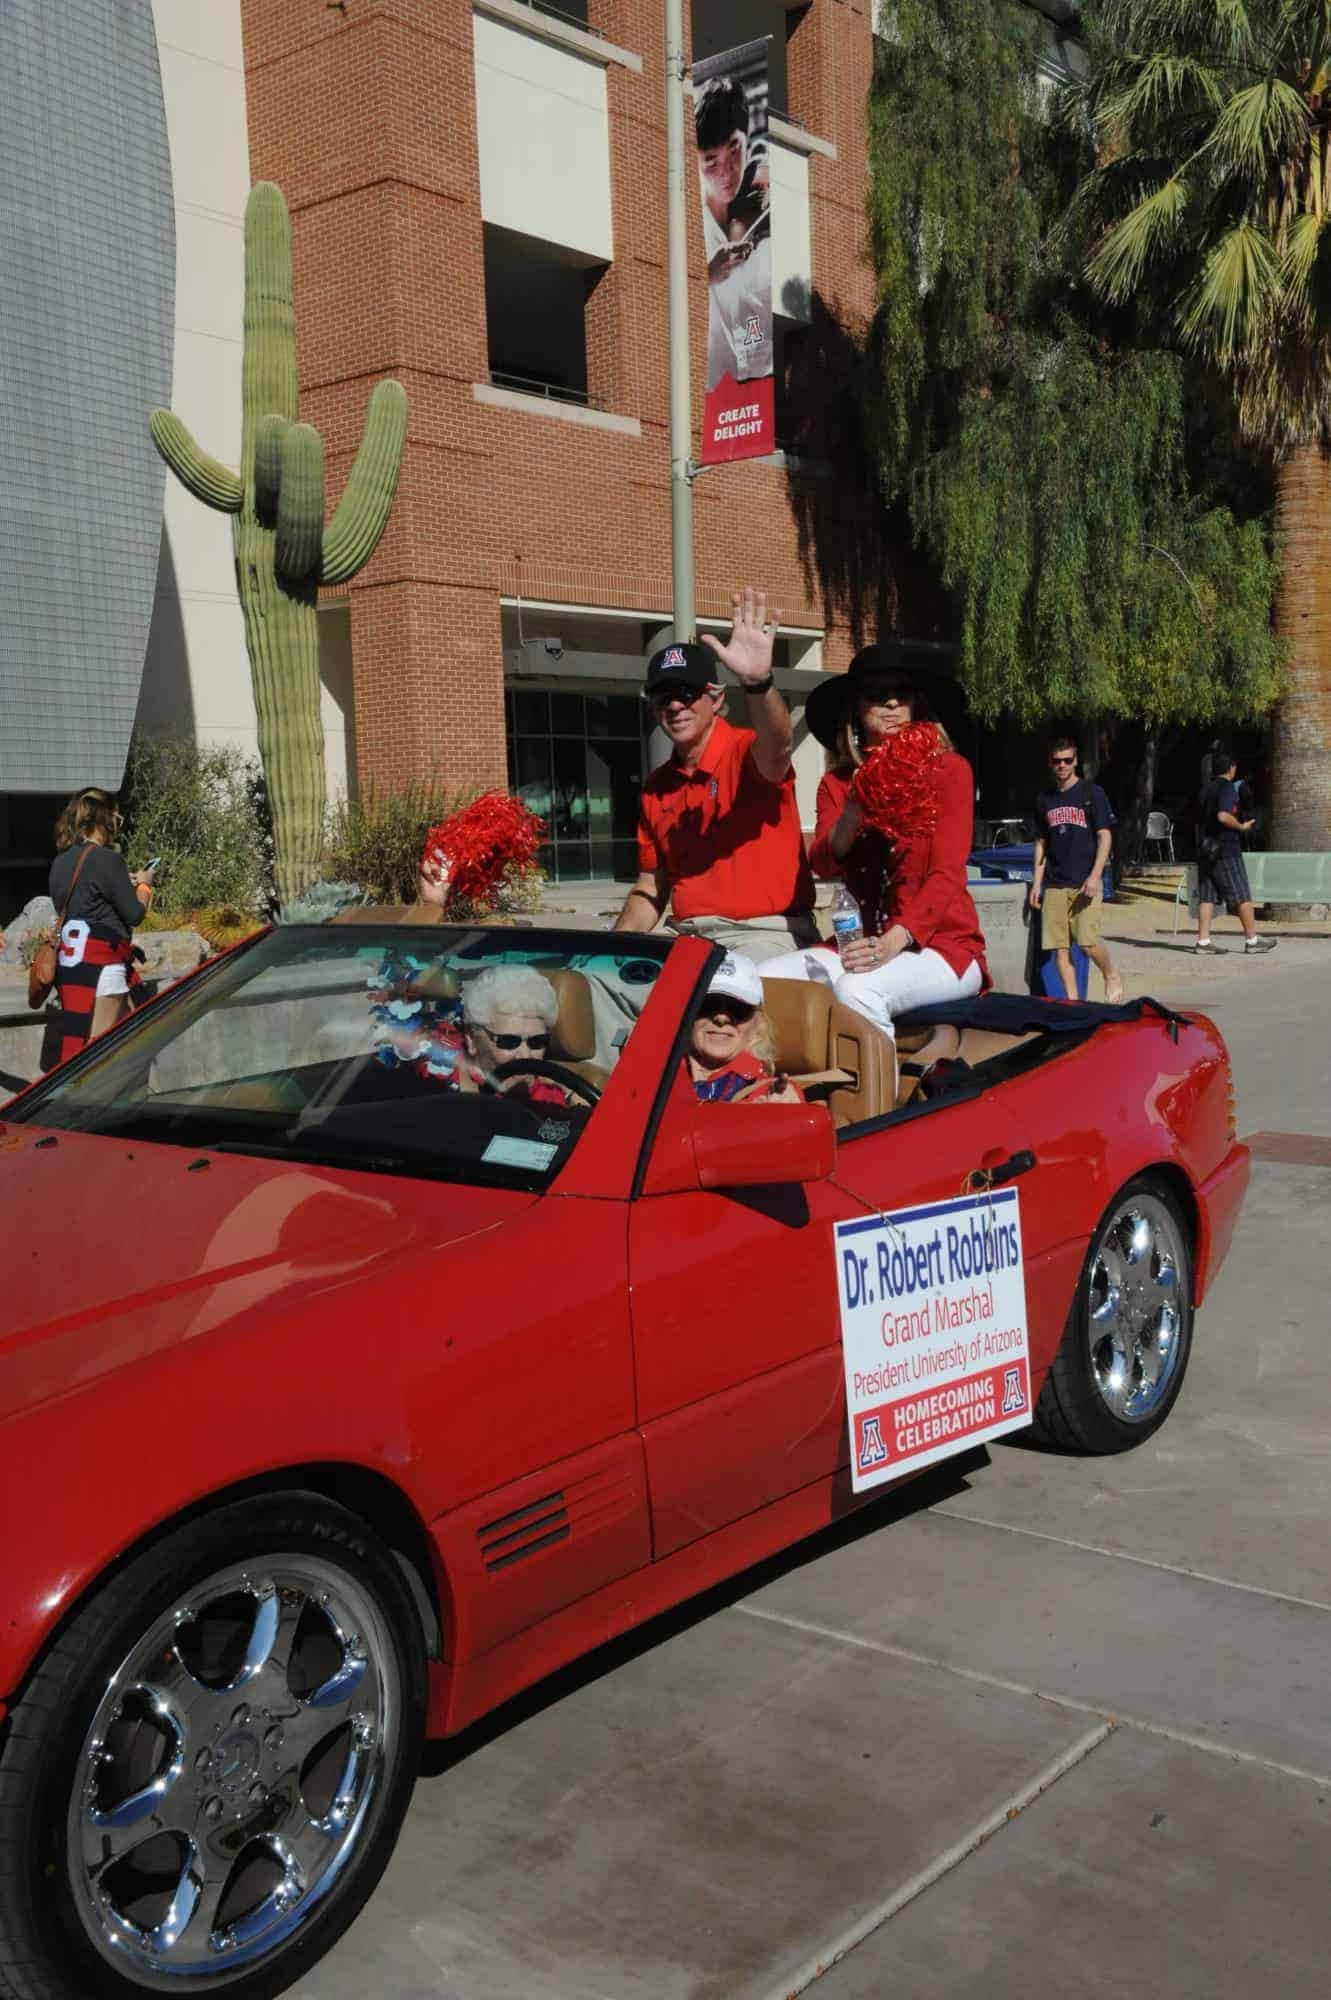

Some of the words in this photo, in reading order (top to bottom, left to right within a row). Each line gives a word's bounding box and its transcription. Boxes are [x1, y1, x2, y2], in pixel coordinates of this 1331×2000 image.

[743, 317, 763, 345] A
[713, 420, 763, 441] DELIGHT
[717, 404, 760, 425] CREATE
[661, 648, 687, 669] A
[59, 920, 90, 967] 9
[843, 1247, 875, 1309] Dr.
[878, 1231, 945, 1300] Robert
[947, 1209, 1019, 1281] Robbins
[882, 1299, 931, 1347] Grand
[935, 1282, 994, 1334] Marshal
[853, 1359, 910, 1400] President
[911, 1340, 968, 1383] University
[970, 1337, 983, 1361] of
[984, 1327, 1024, 1355] Arizona
[894, 1377, 994, 1429] HOMECOMING
[1001, 1370, 1025, 1413] A
[860, 1415, 886, 1466] A
[896, 1401, 995, 1451] CELEBRATION
